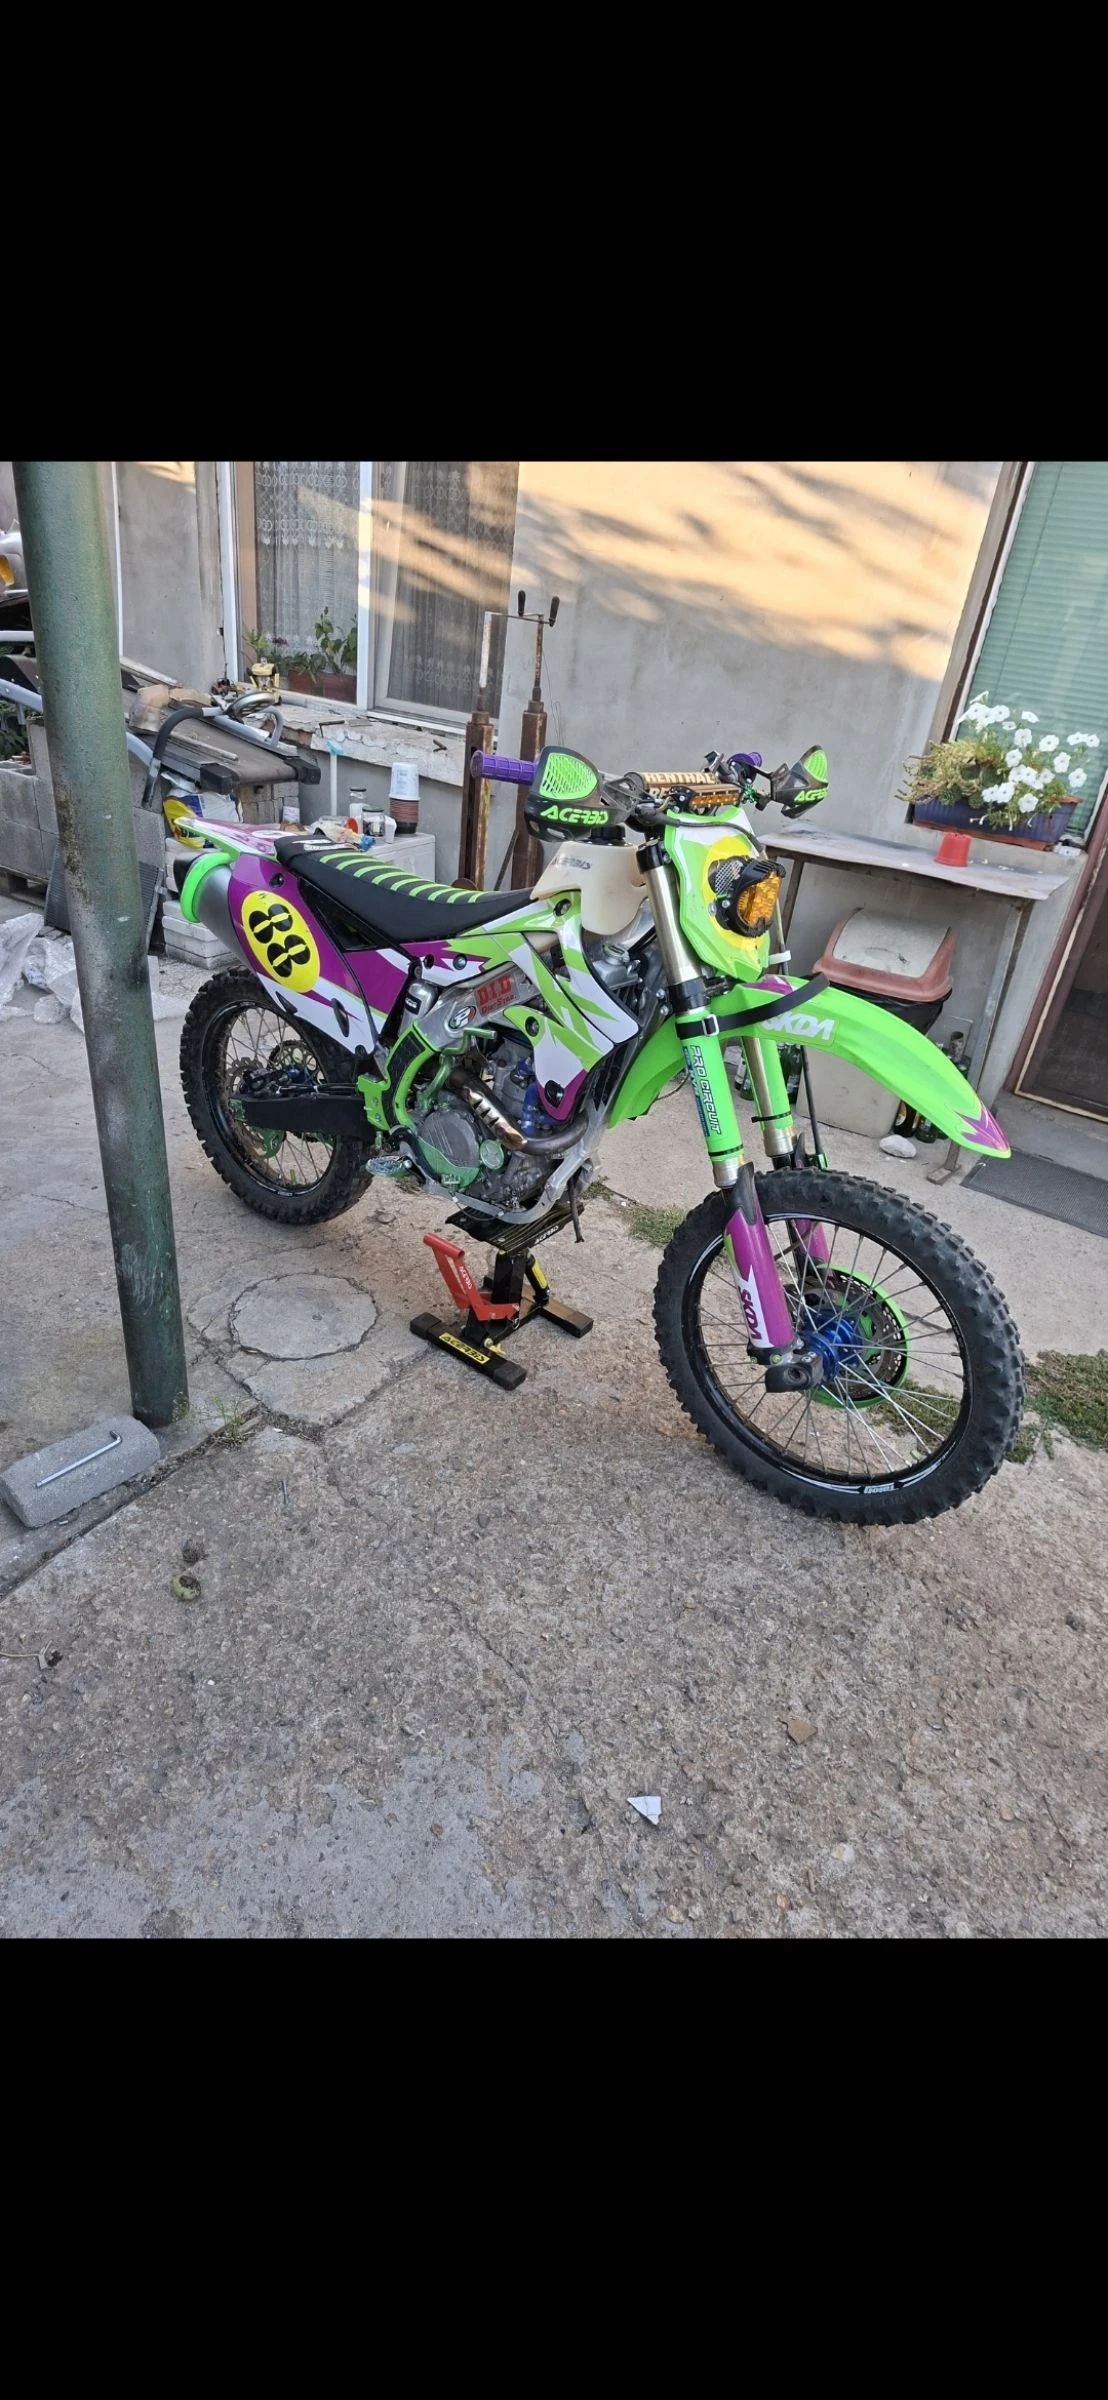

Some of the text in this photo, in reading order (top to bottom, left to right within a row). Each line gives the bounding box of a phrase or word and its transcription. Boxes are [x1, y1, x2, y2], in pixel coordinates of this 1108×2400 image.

[644, 772, 716, 784] RENTHAL
[249, 903, 310, 977] 88
[690, 1045, 707, 1077] PRO
[700, 1079, 722, 1135] CIRCUIT
[741, 1289, 762, 1340] SKDA
